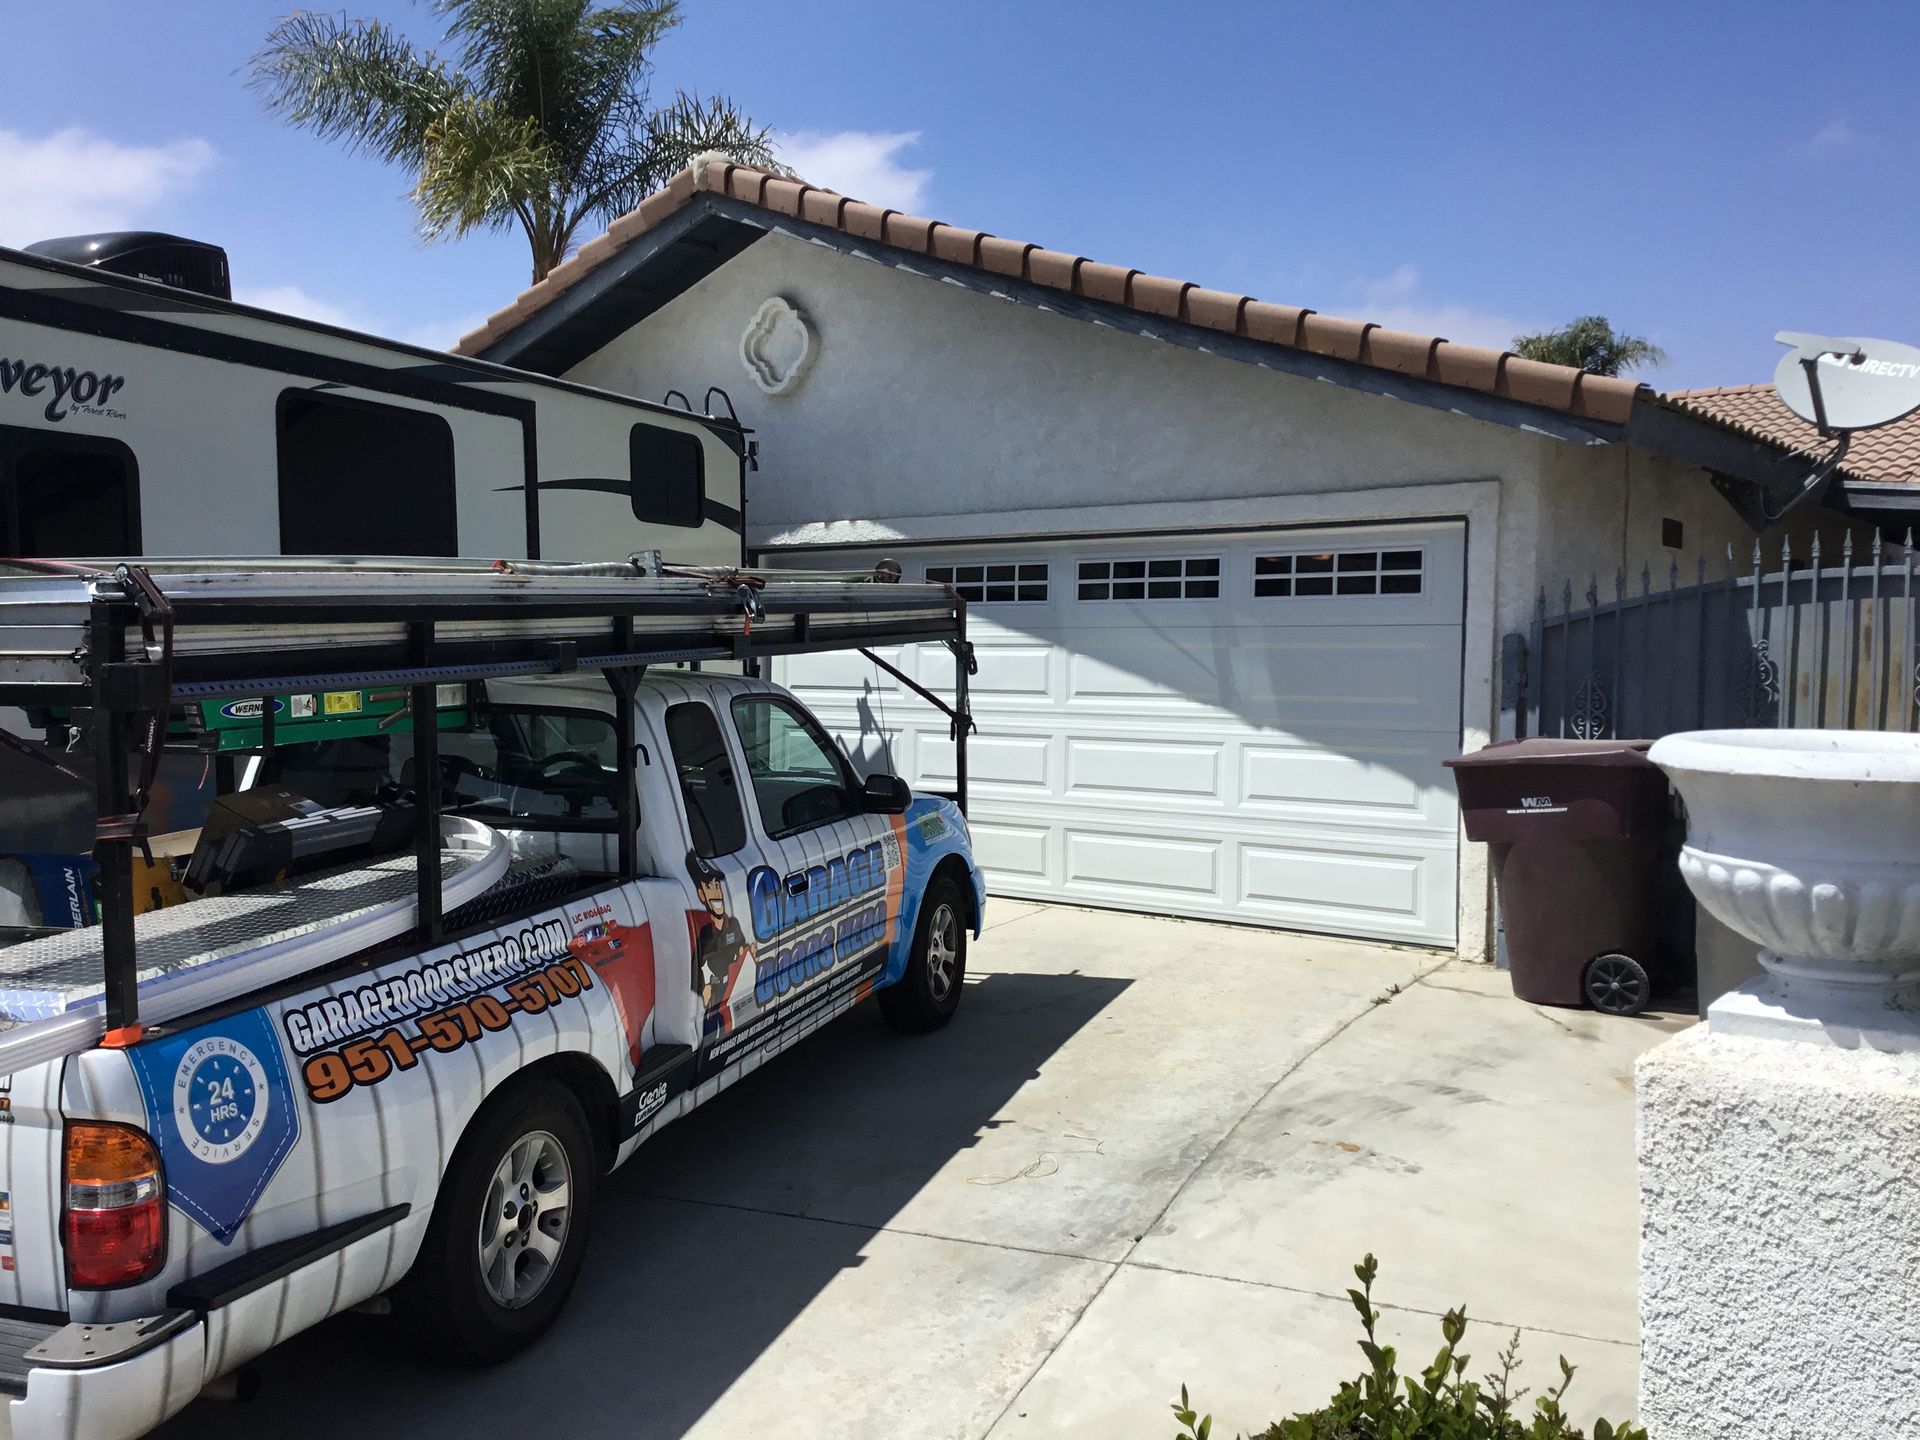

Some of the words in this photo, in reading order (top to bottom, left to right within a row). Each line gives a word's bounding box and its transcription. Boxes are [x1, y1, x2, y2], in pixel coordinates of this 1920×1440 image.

[0, 357, 125, 422] veyor
[747, 841, 886, 943] GARAGE
[754, 926, 836, 1008] DOORS
[834, 899, 888, 963] HERO
[284, 920, 570, 1056] GARAGEDOORSHERO.COM
[303, 957, 594, 1104] 951-570-5707
[177, 1041, 256, 1089] EMERGENCY
[208, 1076, 236, 1106] 24
[210, 1102, 239, 1124] HRS
[639, 1082, 667, 1110] Genie
[191, 1118, 260, 1157] SERVICE
